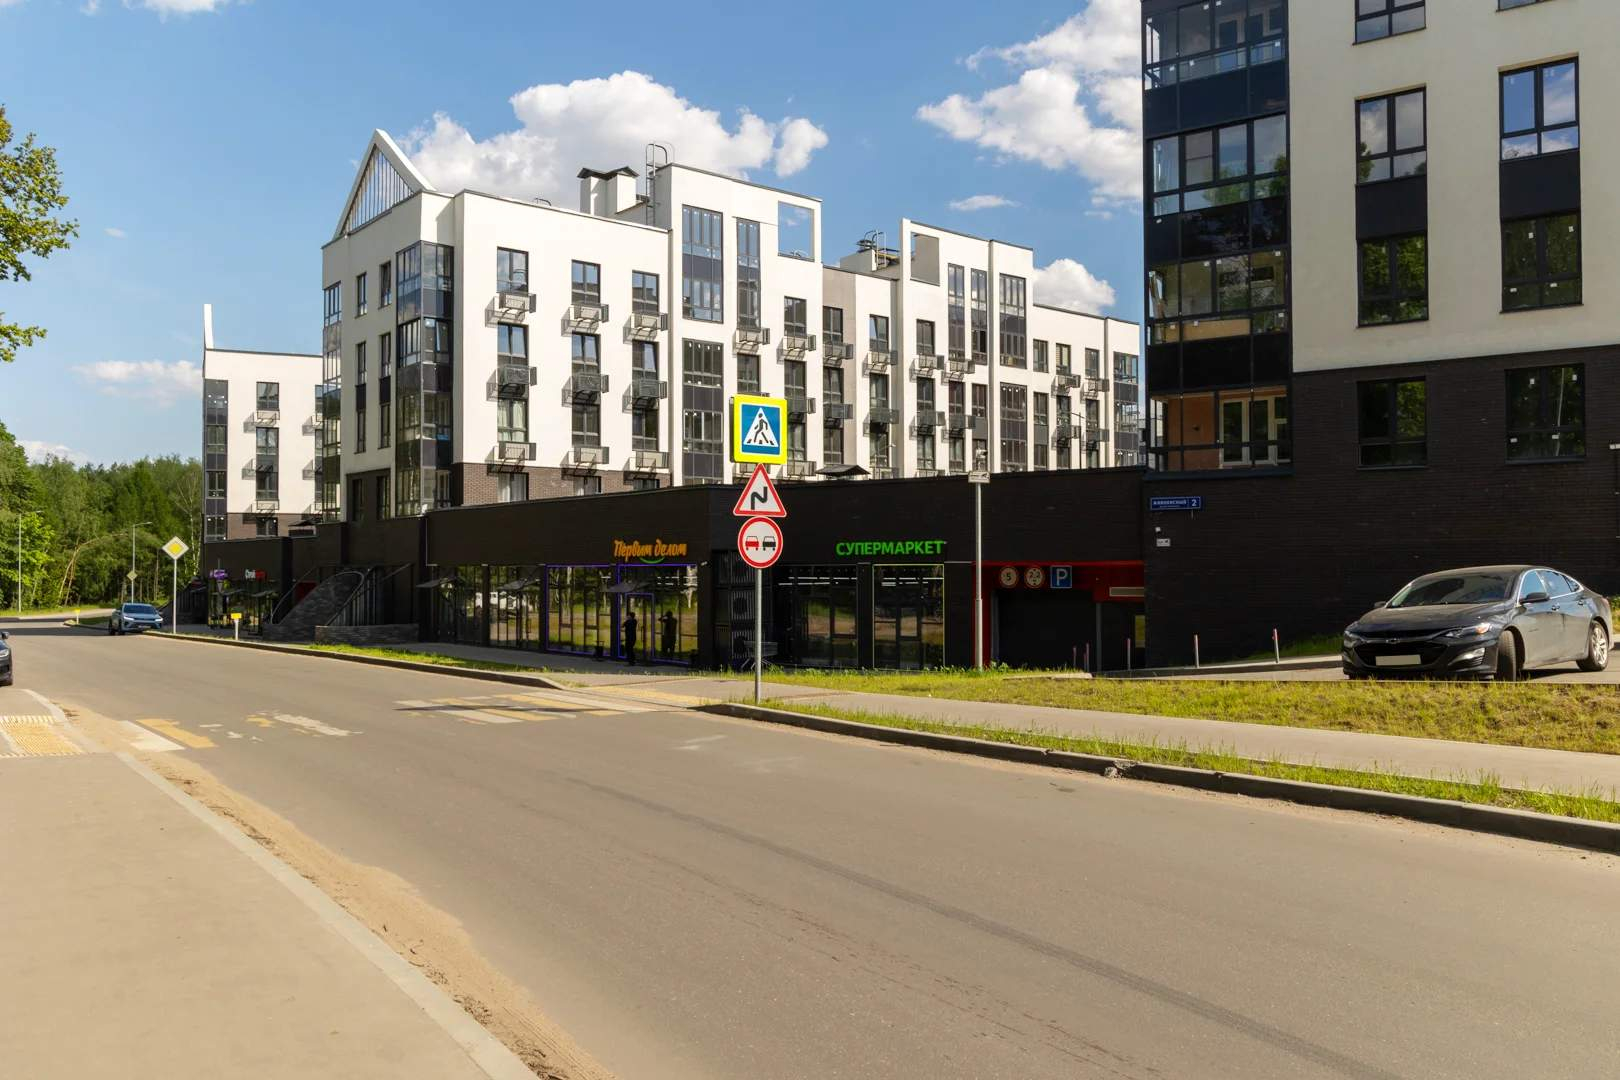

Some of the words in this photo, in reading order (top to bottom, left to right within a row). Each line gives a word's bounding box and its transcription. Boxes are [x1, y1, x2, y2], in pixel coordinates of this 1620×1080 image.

[1191, 498, 1198, 507] 2
[835, 540, 945, 556] СУПЕРМАРКЕТ
[1006, 572, 1012, 581] 5
[1056, 568, 1069, 587] P
